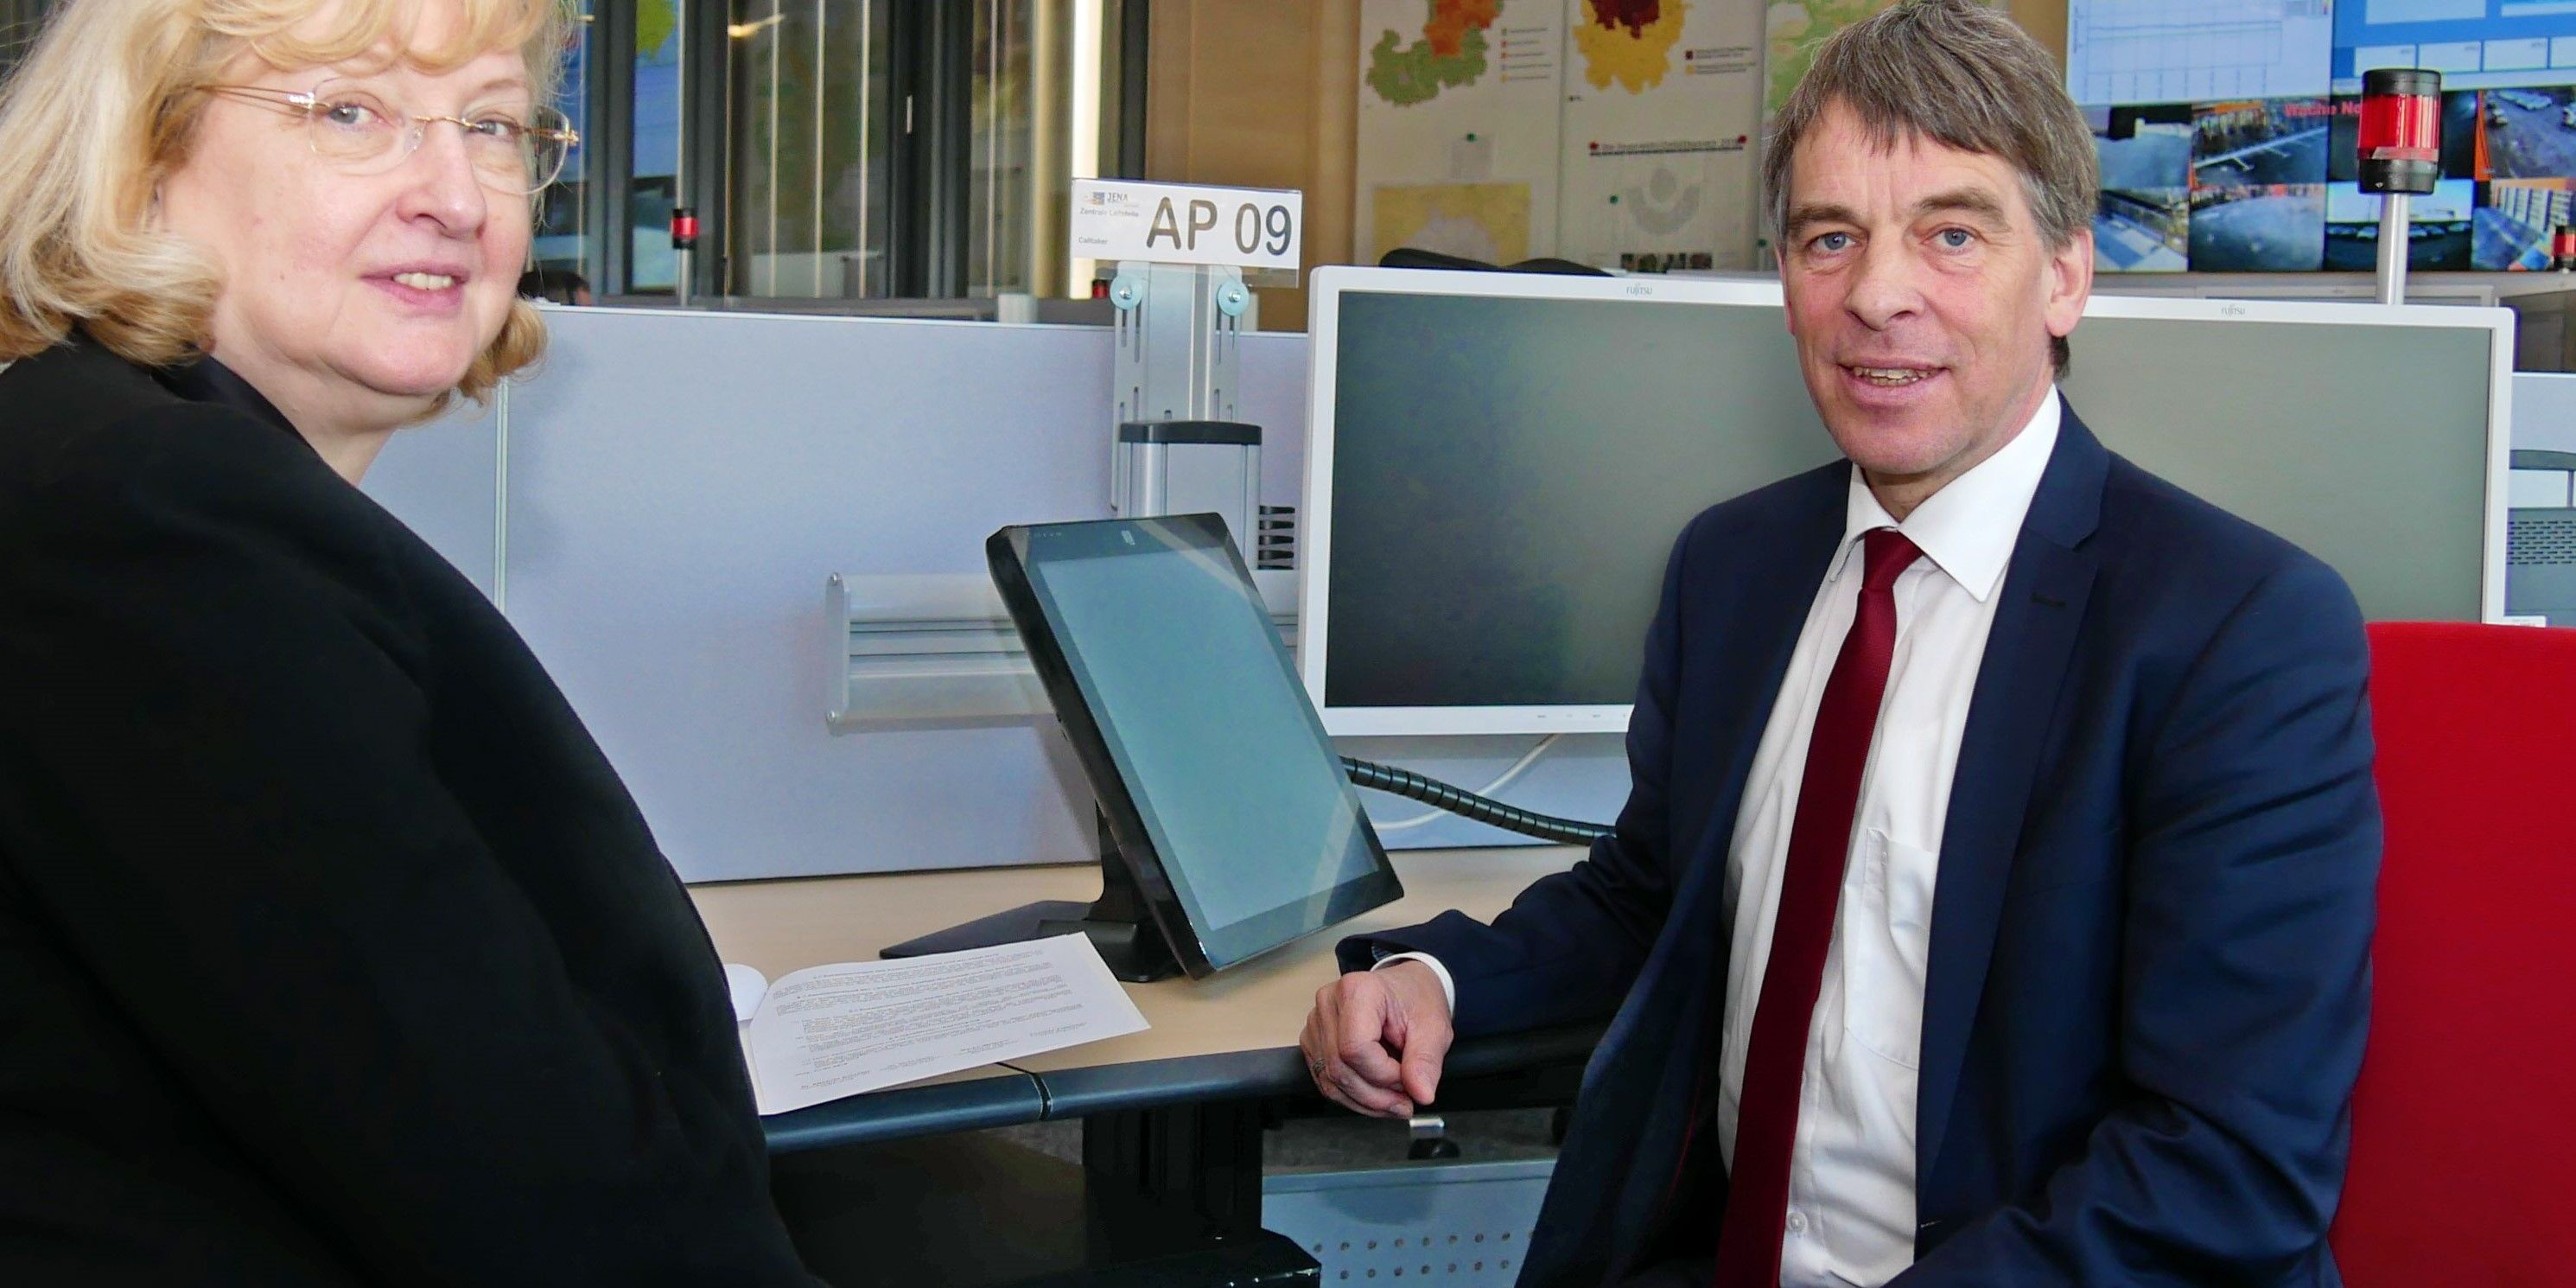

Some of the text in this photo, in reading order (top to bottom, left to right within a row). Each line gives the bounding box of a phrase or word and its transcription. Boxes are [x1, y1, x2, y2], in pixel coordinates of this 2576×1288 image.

[1107, 192, 1129, 201] JENA
[1147, 196, 1292, 256] AP 09
